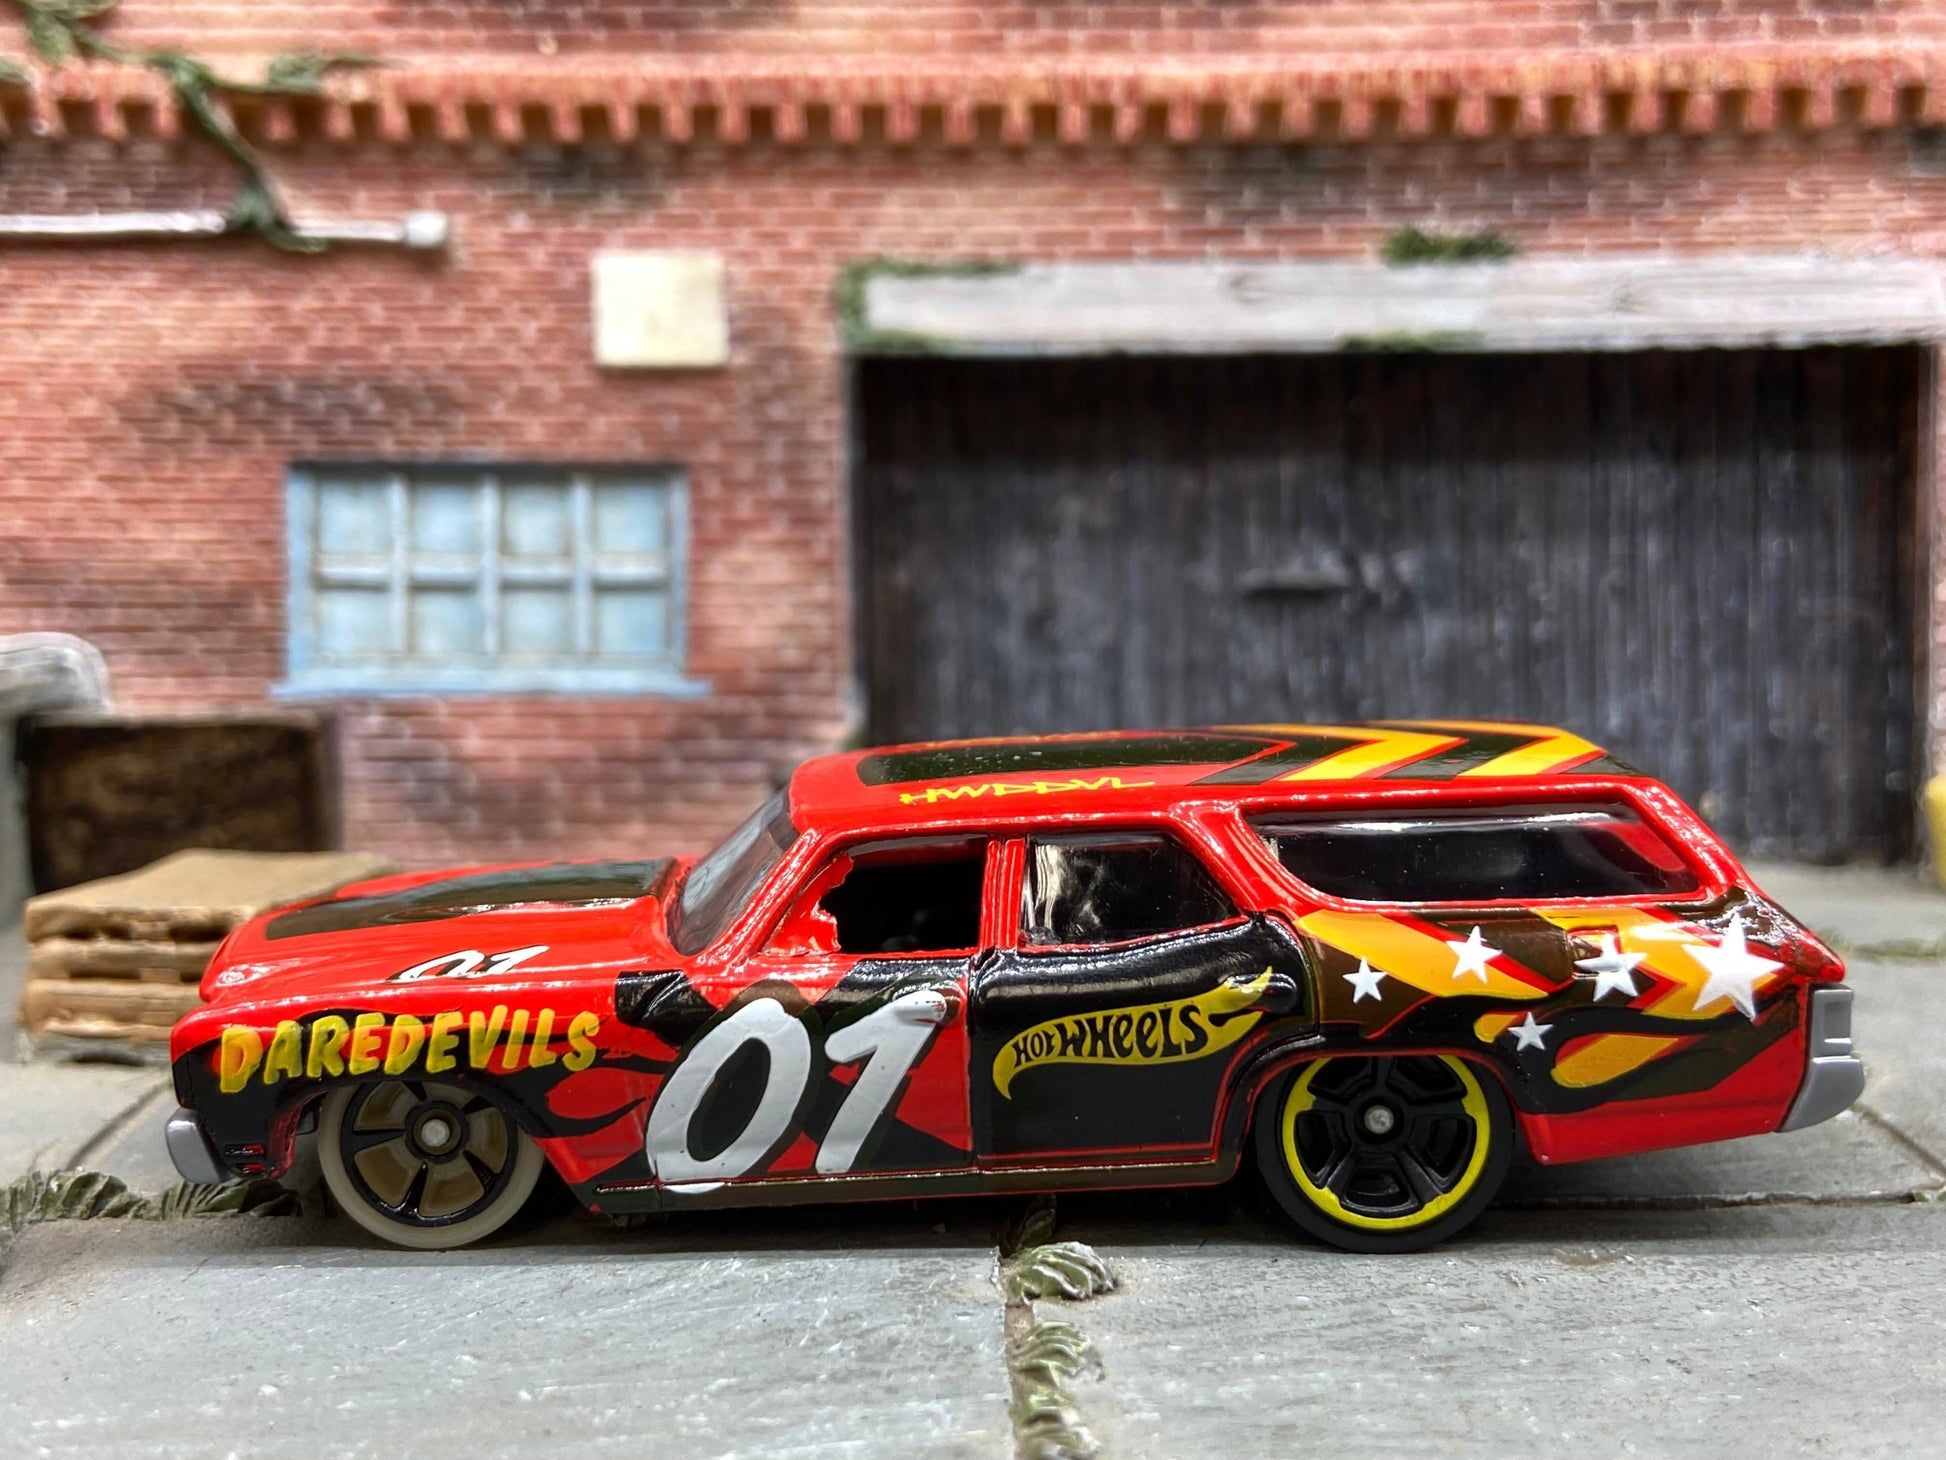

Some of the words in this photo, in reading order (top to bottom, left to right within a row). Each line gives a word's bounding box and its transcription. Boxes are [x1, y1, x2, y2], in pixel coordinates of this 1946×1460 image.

[219, 1004, 601, 1094] DAREDEVILS
[645, 989, 948, 1194] 01
[1010, 1031, 1055, 1069] HOT
